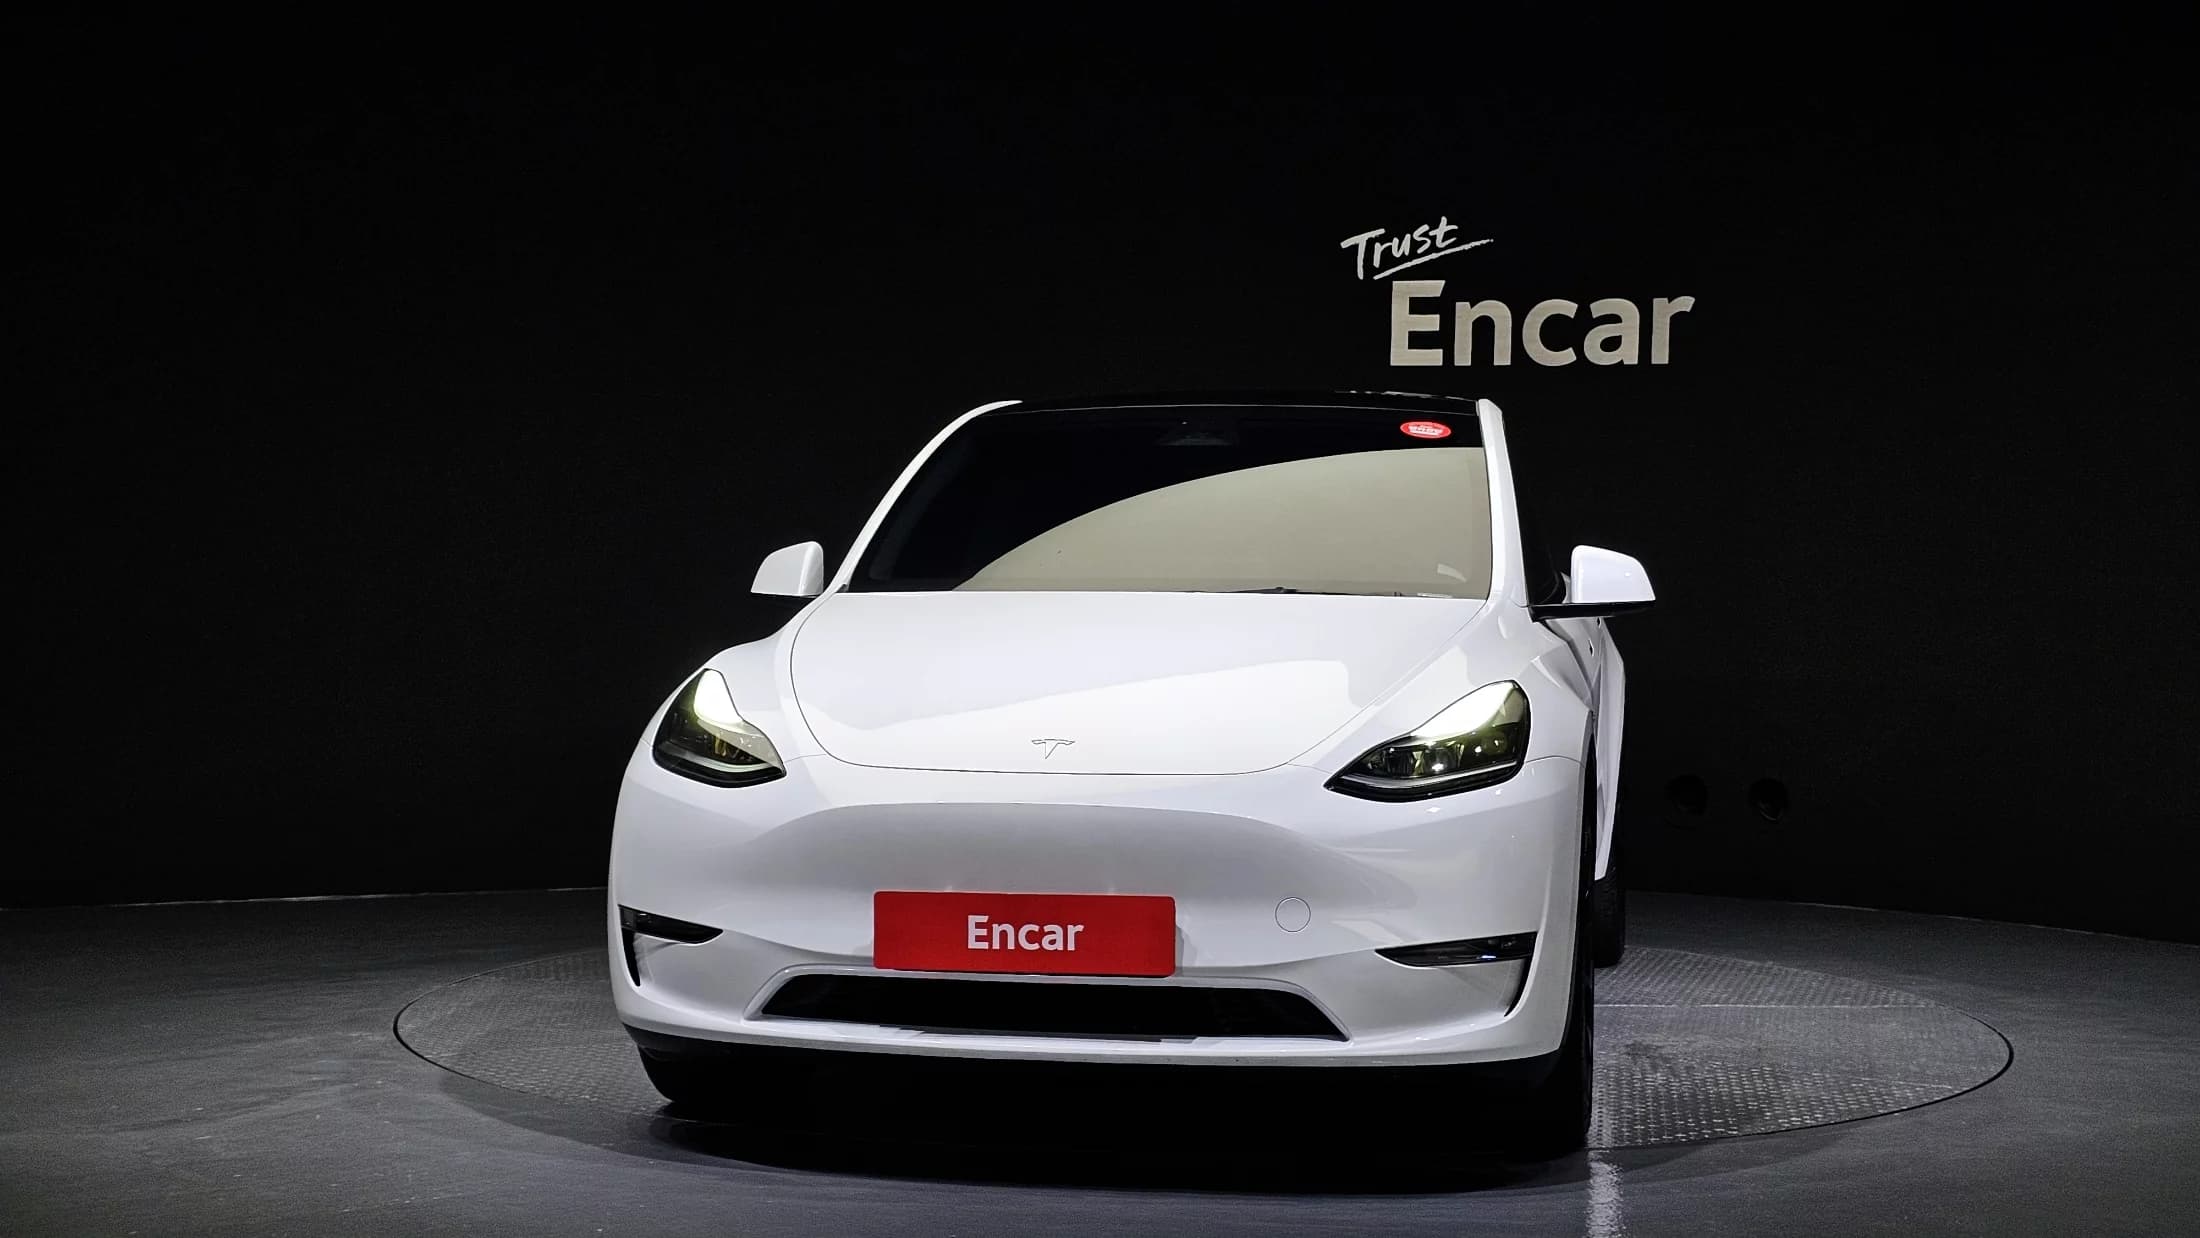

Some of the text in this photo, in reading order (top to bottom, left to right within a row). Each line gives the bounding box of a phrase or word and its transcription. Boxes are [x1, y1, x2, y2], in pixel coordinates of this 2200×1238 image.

[1340, 216, 1459, 280] Trust
[1390, 279, 1696, 367] Encar
[967, 915, 1085, 951] Encar
